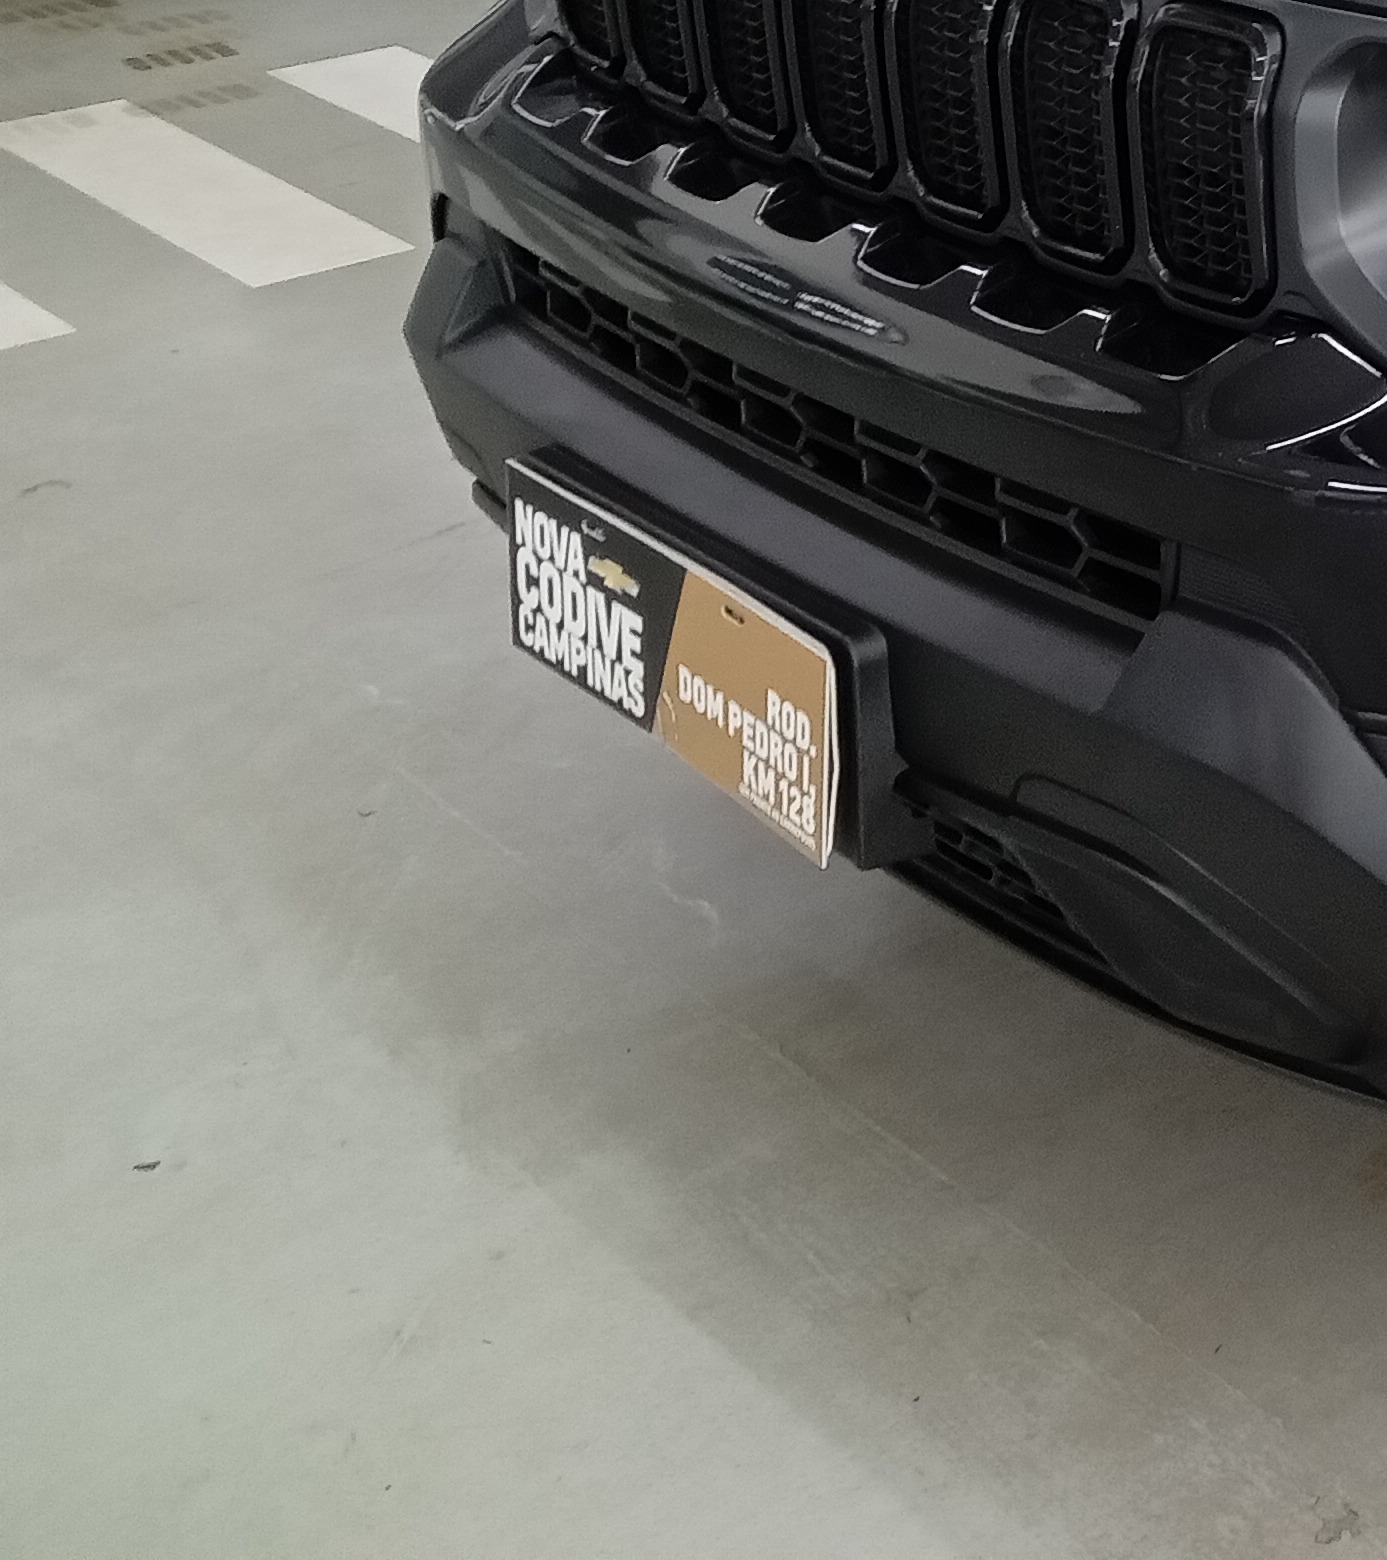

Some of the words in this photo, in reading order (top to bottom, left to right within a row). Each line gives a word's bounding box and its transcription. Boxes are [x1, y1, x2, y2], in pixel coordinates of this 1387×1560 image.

[514, 497, 587, 585] NOVA
[516, 546, 644, 670] CODIVE
[518, 602, 645, 718] CAMPINAS
[678, 663, 725, 729] DOM
[728, 699, 798, 782] PEDRO
[767, 688, 817, 759] ROD.
[743, 748, 776, 806] KM
[779, 778, 816, 835] 128
